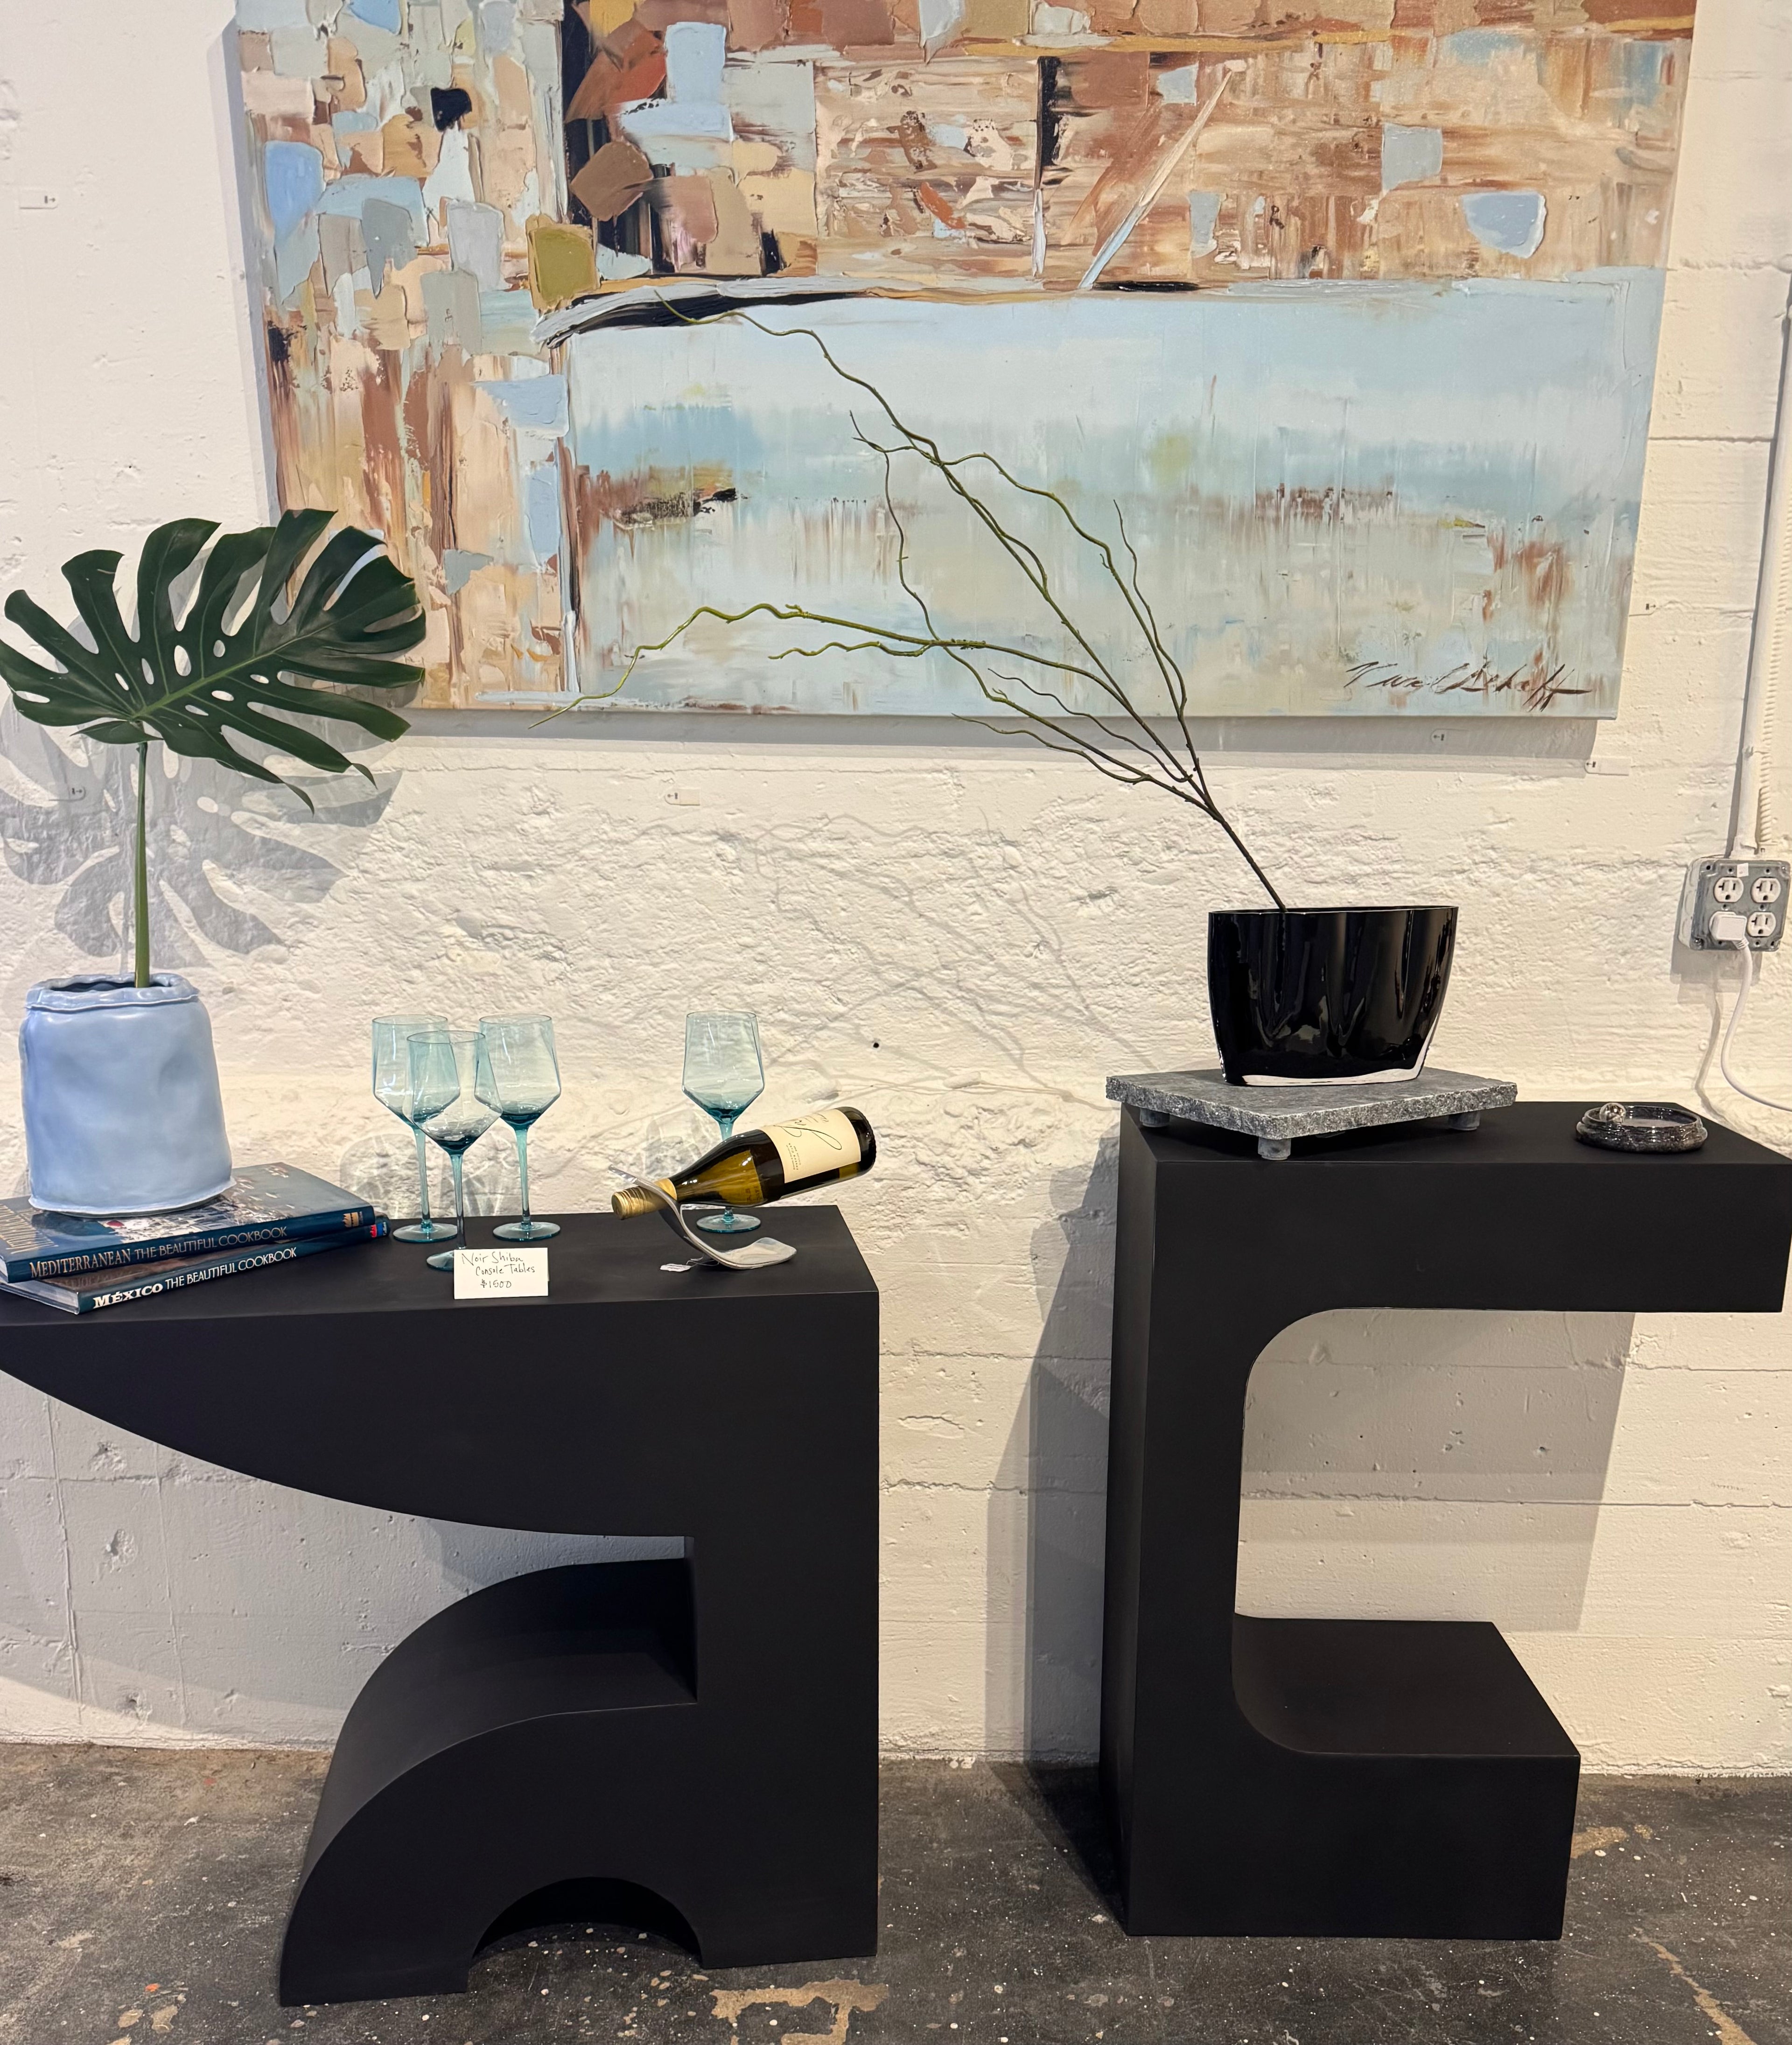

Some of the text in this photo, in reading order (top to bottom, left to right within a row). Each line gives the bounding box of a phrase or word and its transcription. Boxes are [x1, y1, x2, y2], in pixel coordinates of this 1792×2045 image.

[29, 1226, 287, 1278] MEDITERRANEAN THE BEAUTIFUL COOKBOOK
[462, 1251, 523, 1266] Noir Shiba
[476, 1262, 535, 1275] Console Tables
[93, 1247, 297, 1309] MÉXICO THE BEAUTIFUL COOKBOOK
[480, 1279, 512, 1288] $1500
